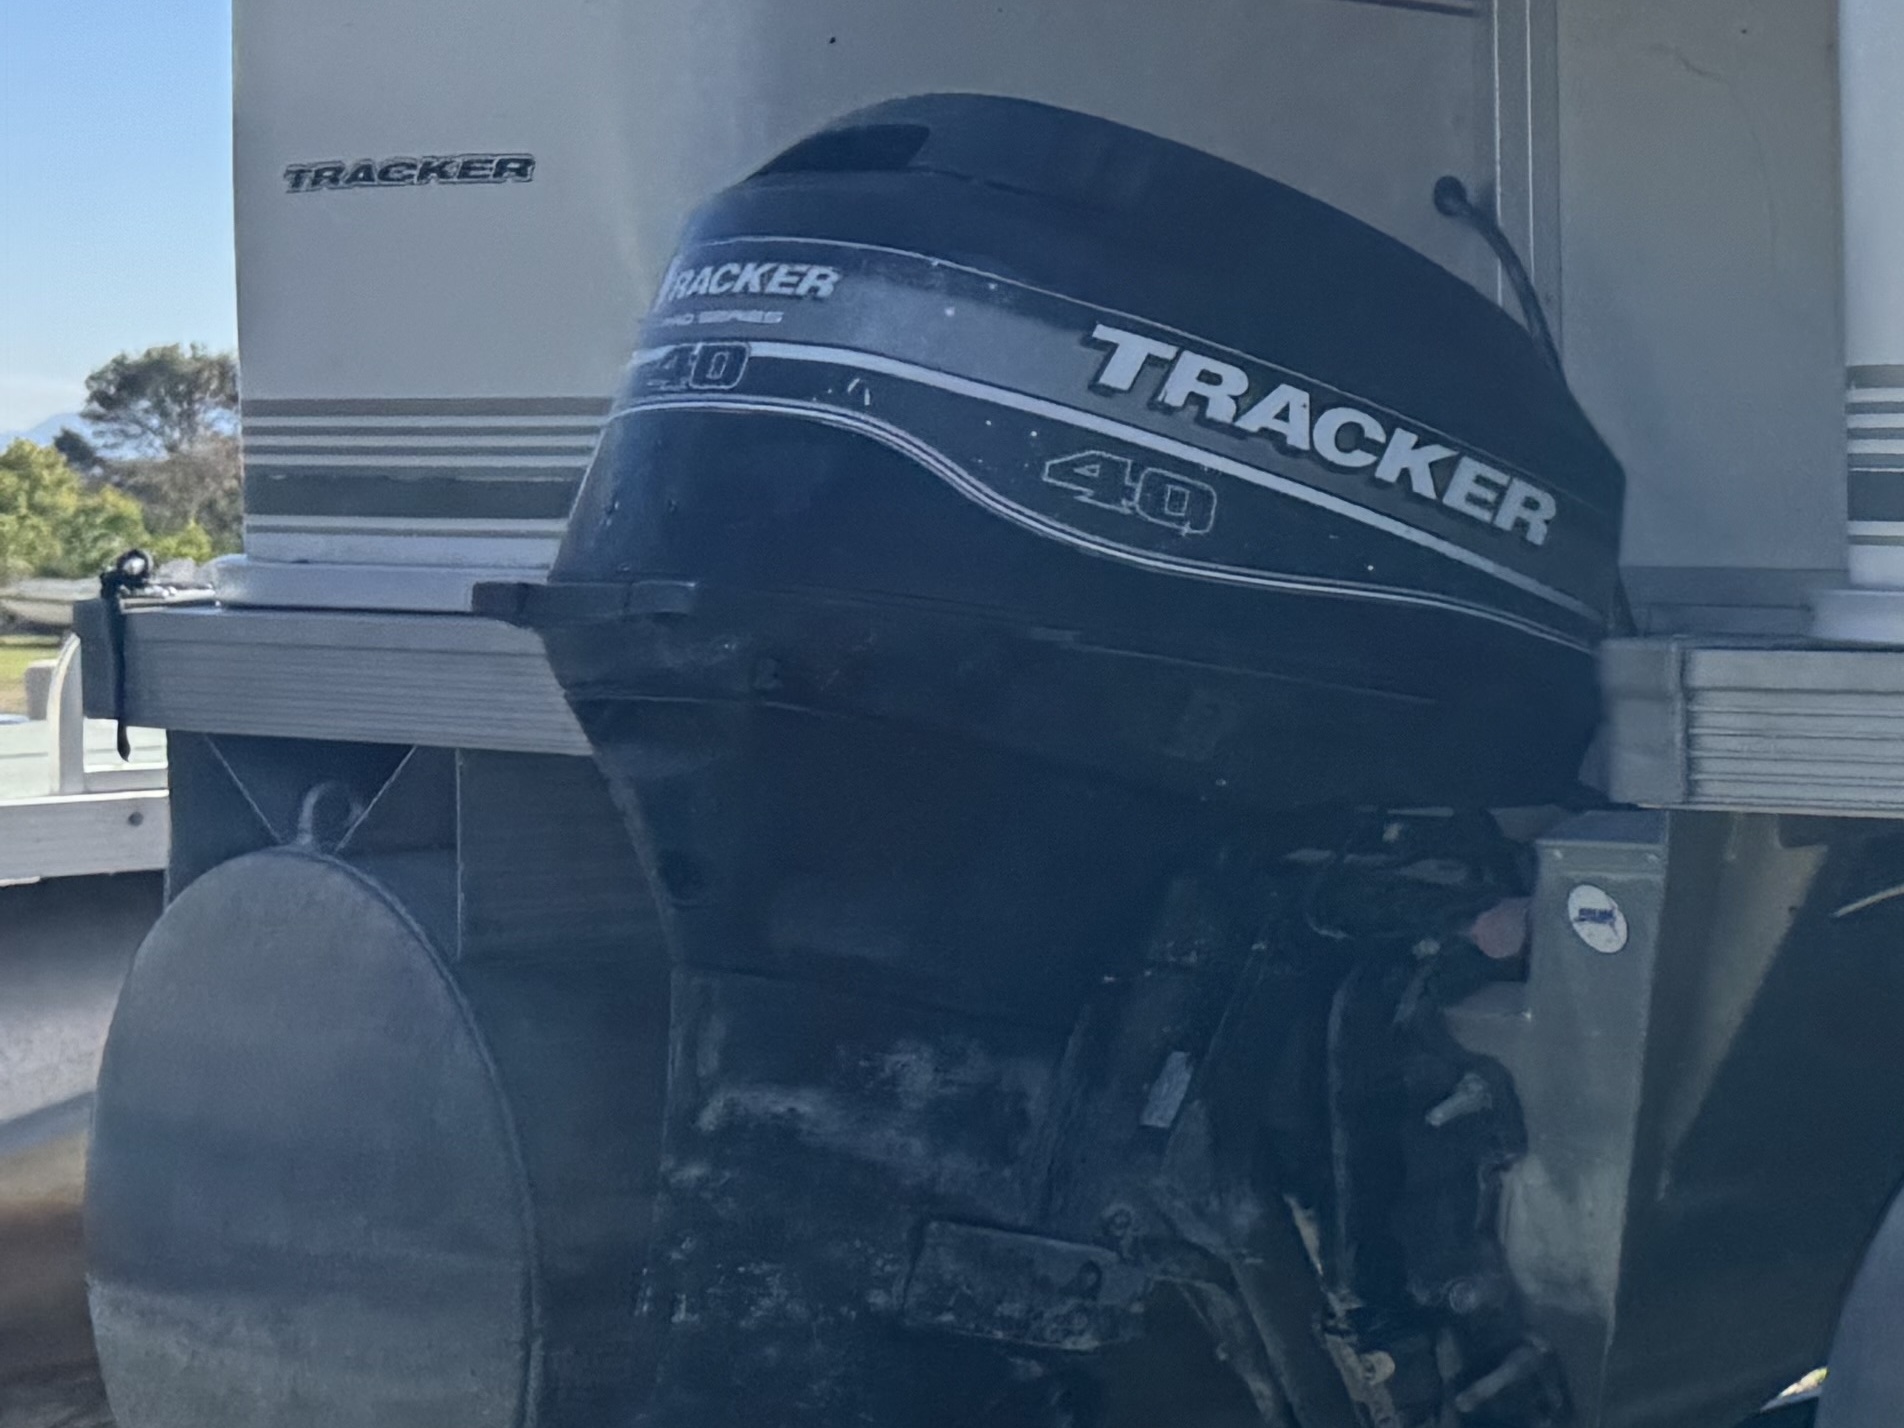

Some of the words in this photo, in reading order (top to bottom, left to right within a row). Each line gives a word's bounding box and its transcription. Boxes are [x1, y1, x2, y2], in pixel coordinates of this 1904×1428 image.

[284, 153, 535, 193] TRACKER
[1092, 323, 1556, 546] TRACKER
[1042, 449, 1217, 536] 40
